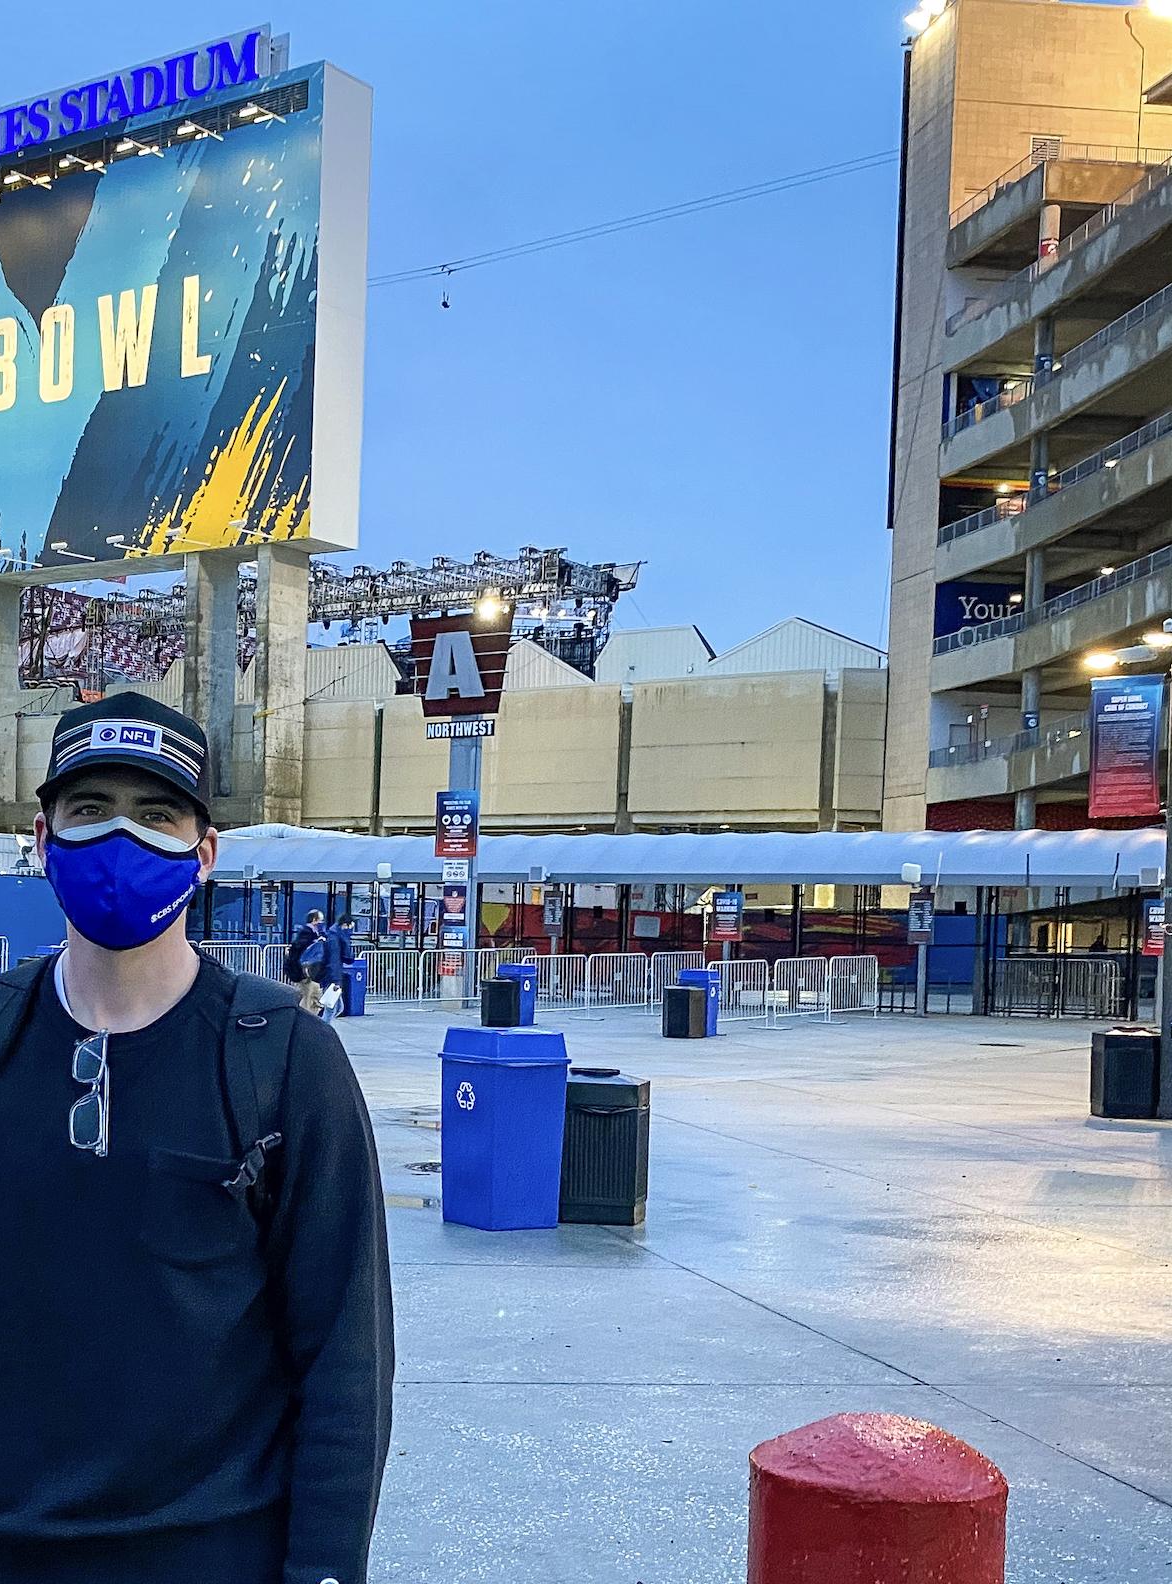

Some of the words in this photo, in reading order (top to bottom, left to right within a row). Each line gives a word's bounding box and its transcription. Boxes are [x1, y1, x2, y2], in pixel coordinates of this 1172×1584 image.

[59, 32, 262, 135] STADIUM
[958, 596, 1017, 620] Your
[425, 631, 485, 701] A
[122, 730, 152, 744] NFL
[427, 720, 494, 738] NORTHWEST
[157, 904, 172, 919] CBS
